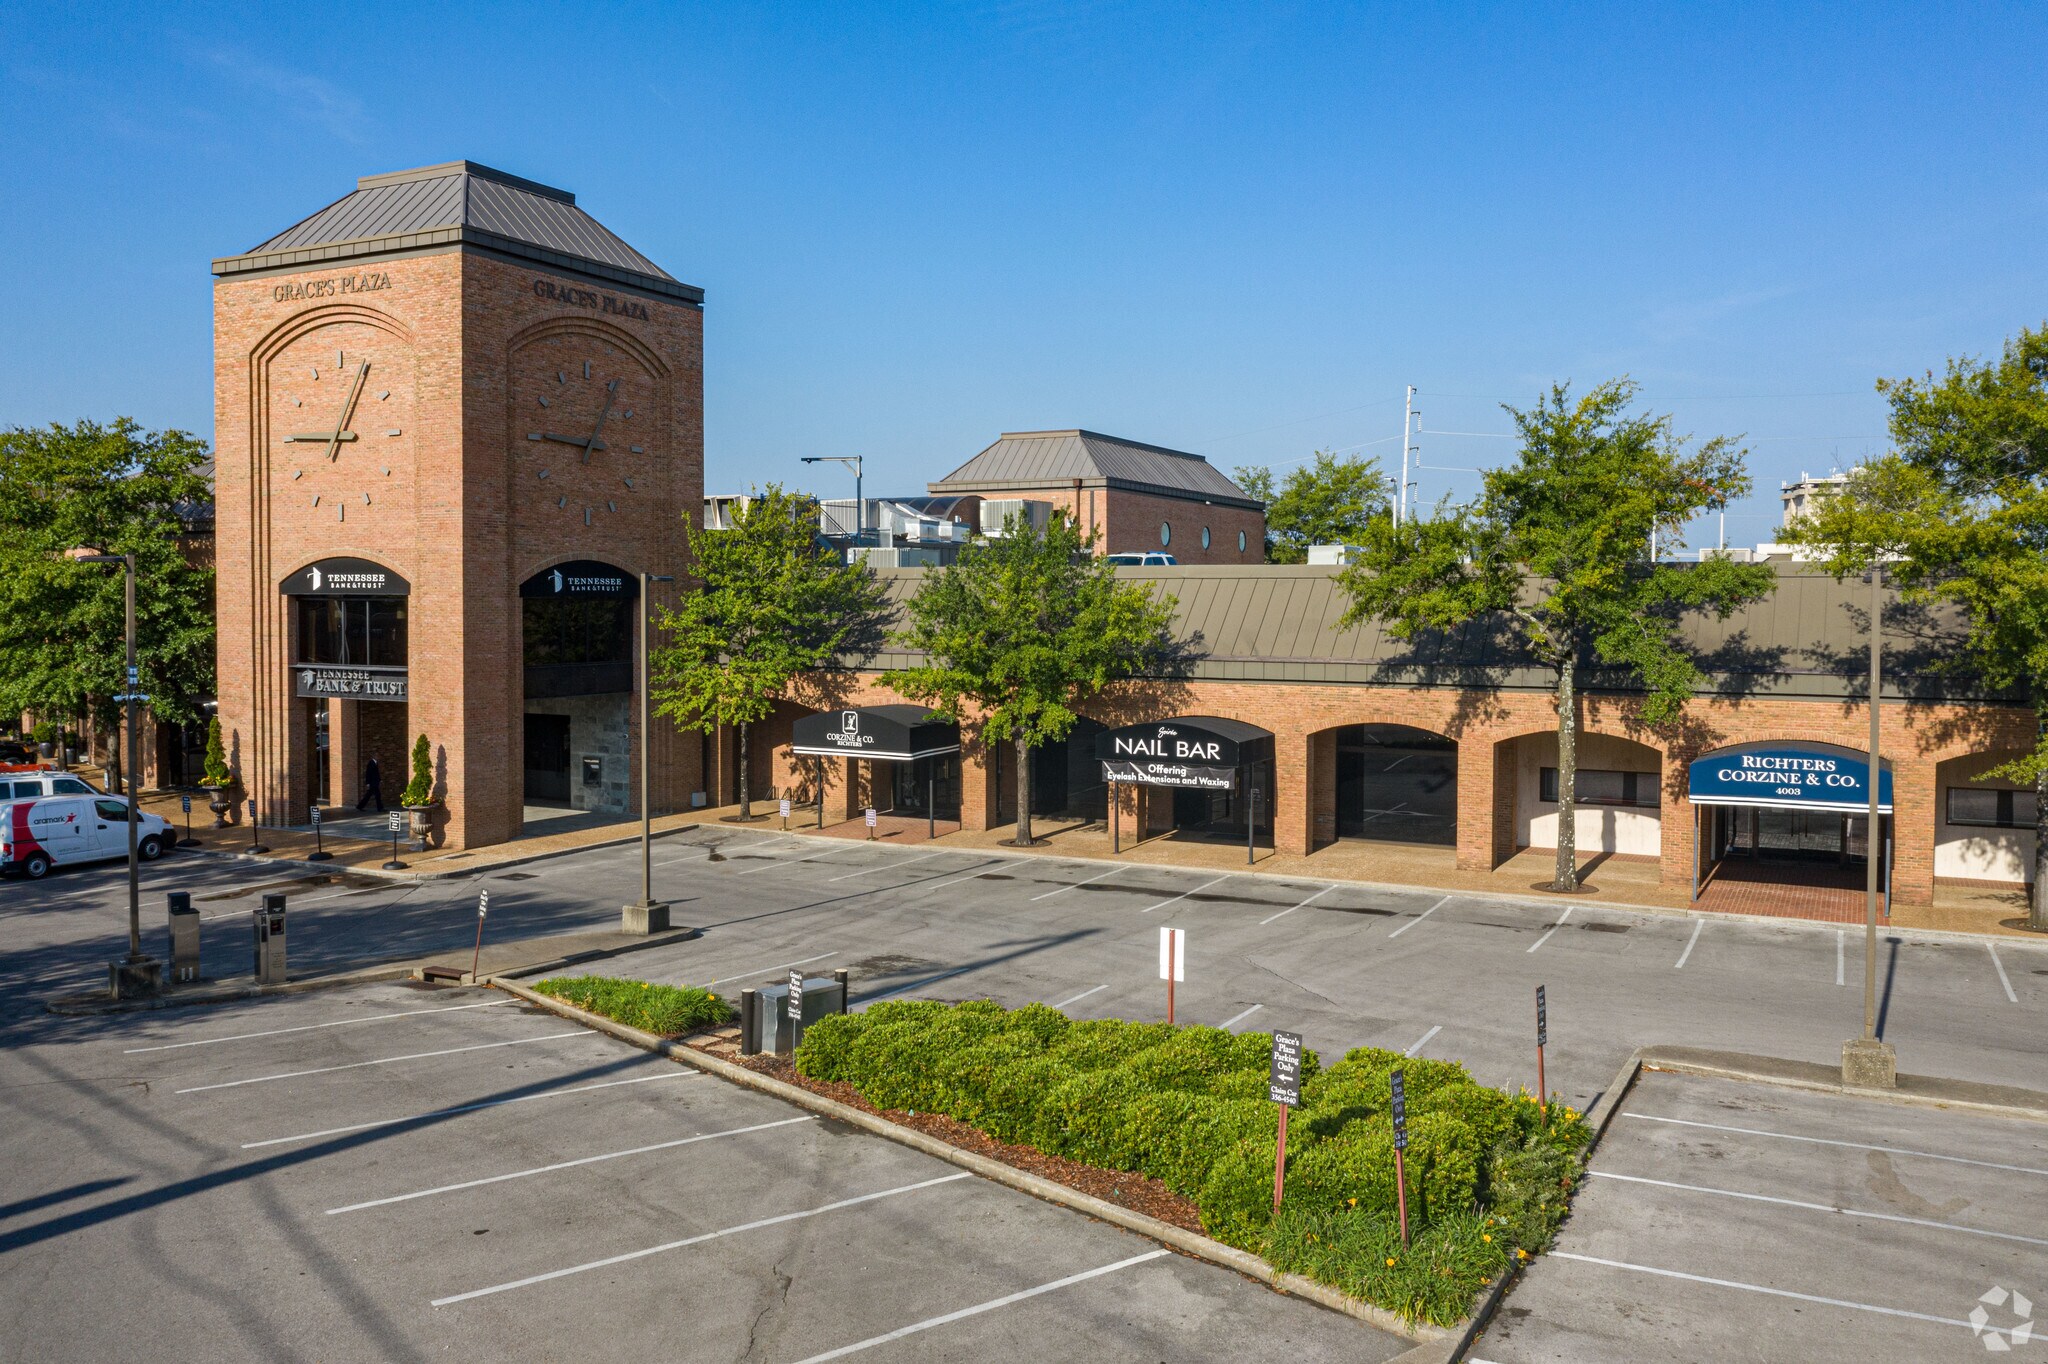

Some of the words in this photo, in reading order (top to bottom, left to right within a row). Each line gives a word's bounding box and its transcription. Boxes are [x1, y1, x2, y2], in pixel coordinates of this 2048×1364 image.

[273, 279, 335, 302] GRACE'S
[340, 272, 392, 294] PLAZA
[533, 279, 598, 309] GRACE'S
[602, 295, 649, 321] PLAZA
[328, 574, 385, 582] TENNESSEE
[568, 577, 622, 586] TENNESSEE
[317, 668, 370, 680] TENNESSEE
[316, 679, 349, 693] BANK
[351, 681, 360, 693] &
[364, 681, 404, 695] TRUST
[826, 732, 856, 742] CORZINE
[856, 735, 862, 743] &
[862, 735, 875, 744] CO.
[1115, 737, 1168, 757] NAIL
[1176, 741, 1221, 760] BAR
[1742, 755, 1836, 771] RICHTERS
[1148, 764, 1187, 777] Offering
[1107, 771, 1137, 782] Eyelash
[1138, 773, 1181, 784] Extensions
[1182, 776, 1198, 785] and
[1199, 777, 1230, 788] Waxing
[1718, 769, 1801, 785] CORZINE
[1806, 773, 1820, 786] &
[1775, 787, 1801, 795] 4003
[33, 815, 65, 825] aramark
[1275, 1033, 1300, 1046] Grace's
[1278, 1043, 1296, 1055] Plaza
[1274, 1051, 1299, 1066] Parking
[1277, 1061, 1294, 1073] Only
[1270, 1085, 1287, 1096] Claim
[1287, 1088, 1298, 1098] Car
